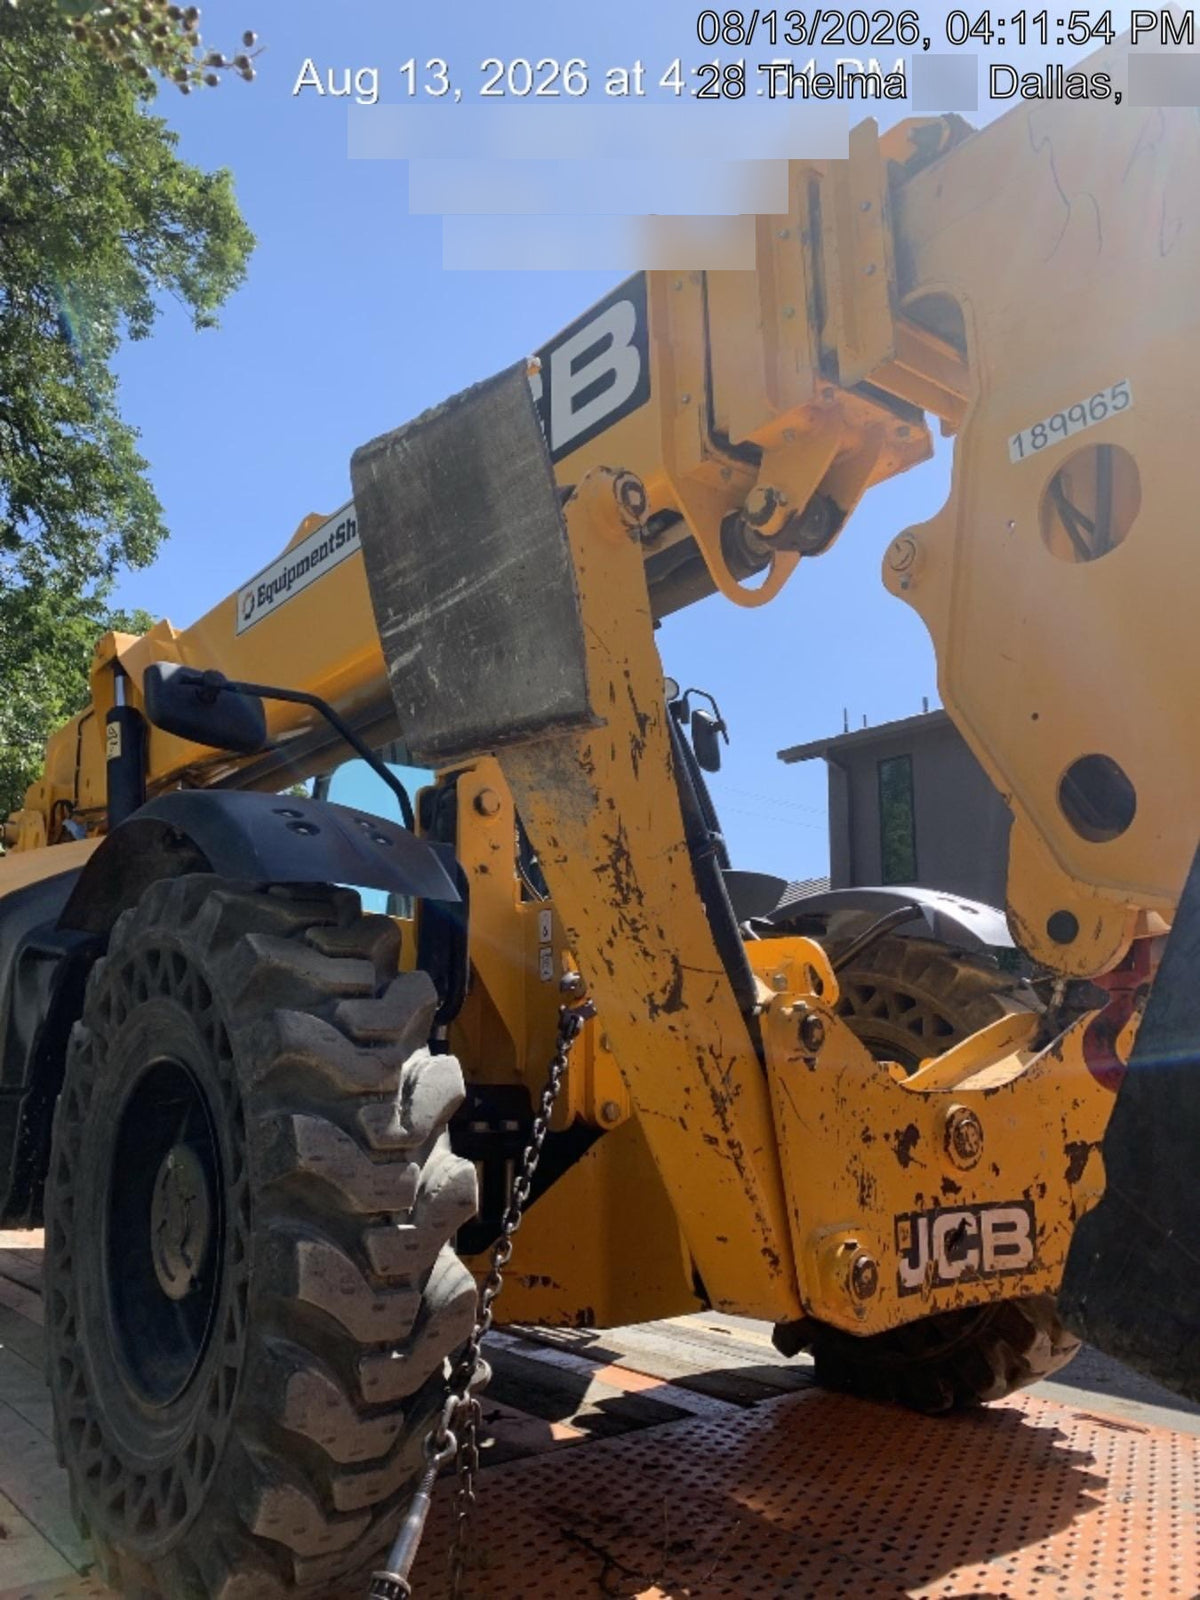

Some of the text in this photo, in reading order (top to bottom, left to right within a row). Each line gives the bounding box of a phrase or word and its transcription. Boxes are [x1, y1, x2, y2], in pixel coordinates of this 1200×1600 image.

[527, 300, 641, 452] B
[1012, 380, 1130, 458] 189965
[899, 1207, 1034, 1288] JCB
